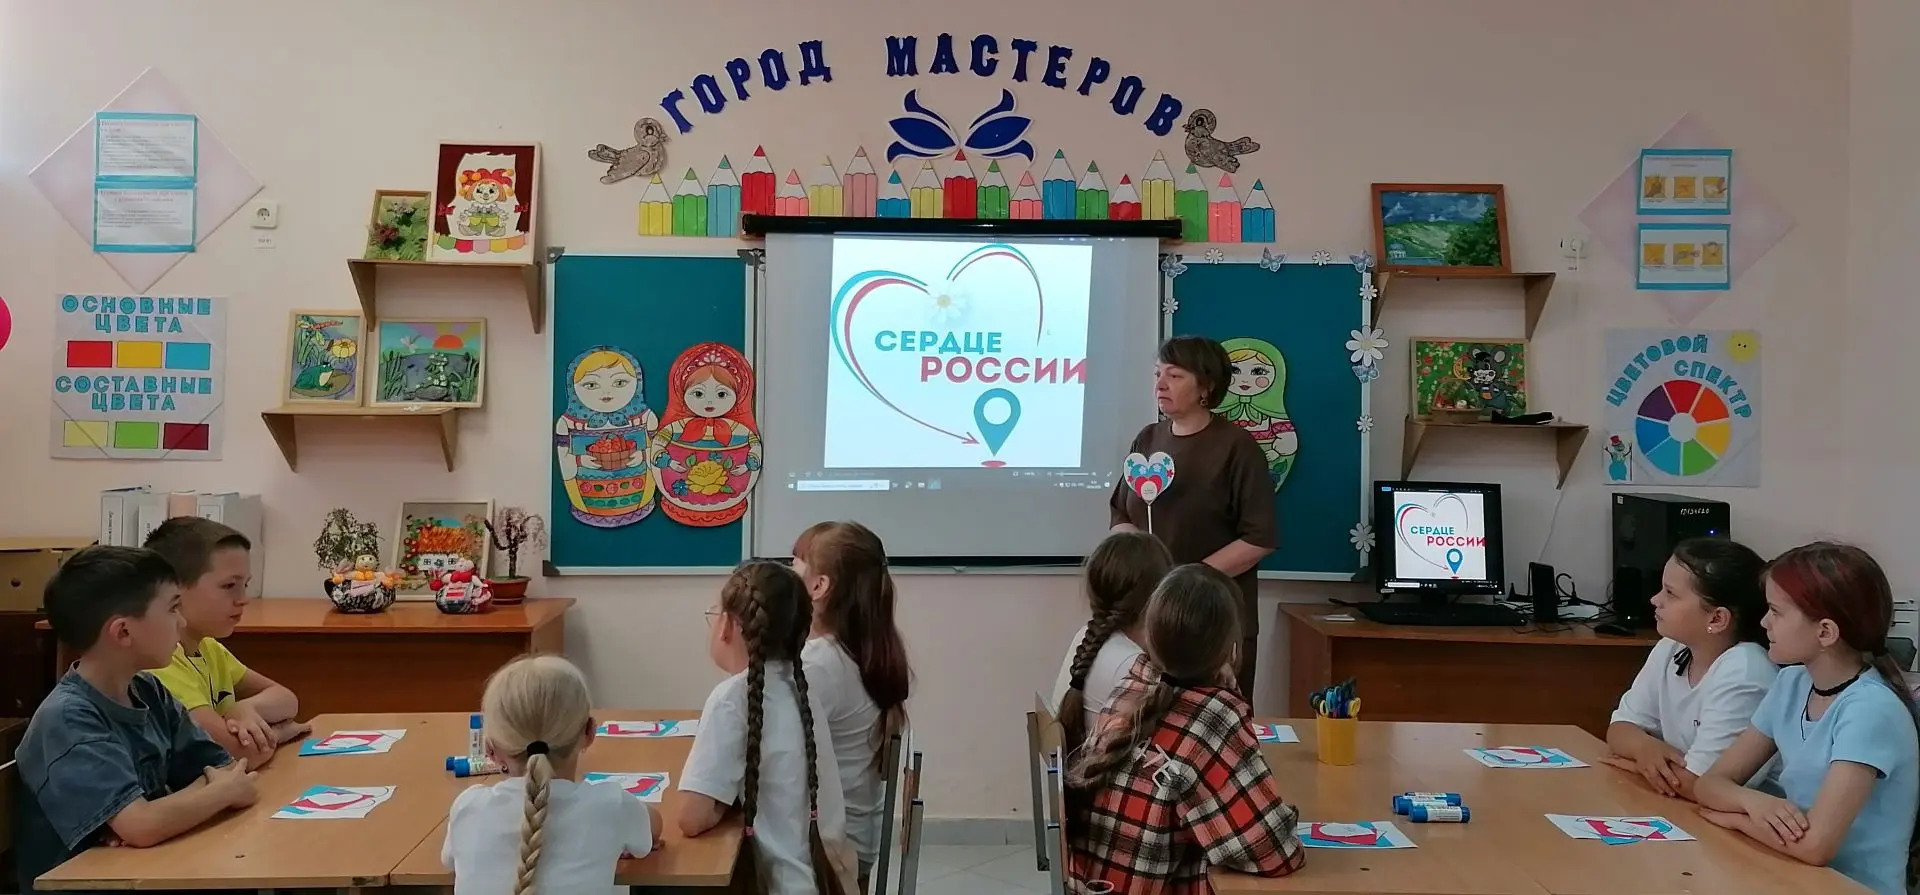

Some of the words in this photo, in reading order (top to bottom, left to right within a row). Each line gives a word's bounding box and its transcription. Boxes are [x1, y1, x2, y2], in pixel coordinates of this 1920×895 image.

[660, 39, 832, 134] ГОРОД
[884, 33, 1183, 136] МАСТЕРОВ
[62, 294, 211, 316] ОСНОВНЫЕ
[95, 313, 183, 333] ЦВЕТА
[874, 330, 1002, 354] СЕРДЦЕ
[920, 356, 1087, 384] РОССИИ
[1606, 334, 1708, 407] ЦВЕТОВОЙ
[55, 375, 212, 394] СОСТАВНЫЕ
[1673, 359, 1752, 418] СПЕКТР
[91, 393, 176, 412] ЦВЕТА
[1410, 526, 1455, 536] СЕРДЦЕ
[1426, 536, 1487, 547] РОССИИ
